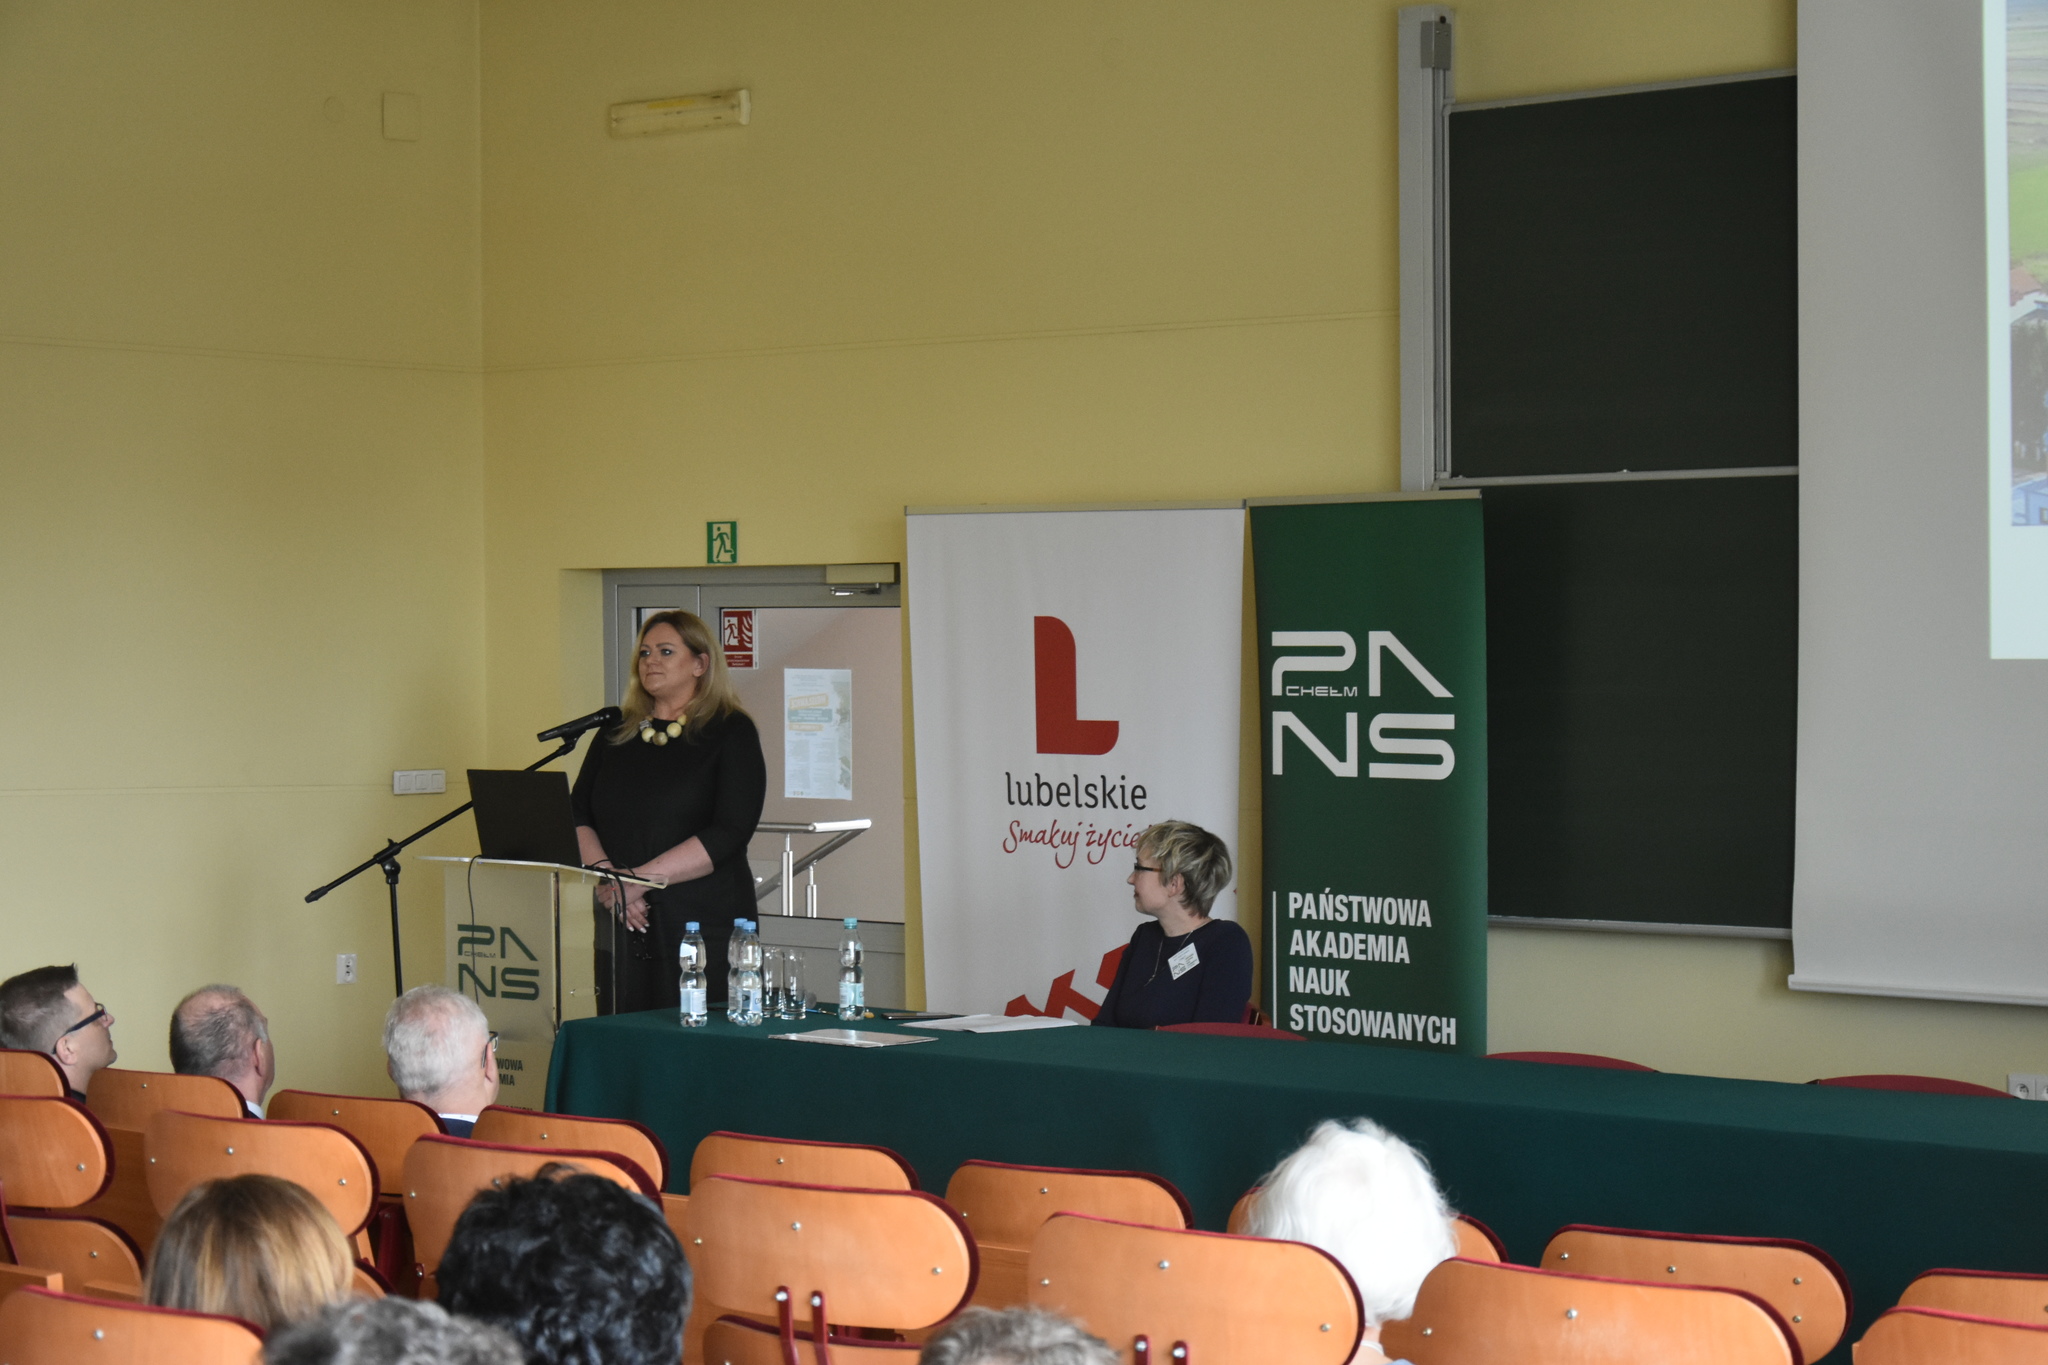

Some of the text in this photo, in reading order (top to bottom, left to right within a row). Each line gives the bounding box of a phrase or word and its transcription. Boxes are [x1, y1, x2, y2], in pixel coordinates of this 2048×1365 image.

[1286, 686, 1358, 697] CHEŁM
[1005, 771, 1147, 811] lubelskie
[1002, 819, 1153, 869] Smakuj życie
[1288, 887, 1432, 927] PAŃSTWOWA
[1289, 929, 1411, 964] AKADEMIA
[1289, 966, 1351, 997] NAUK
[1290, 1003, 1457, 1046] STOSOWANYCH
